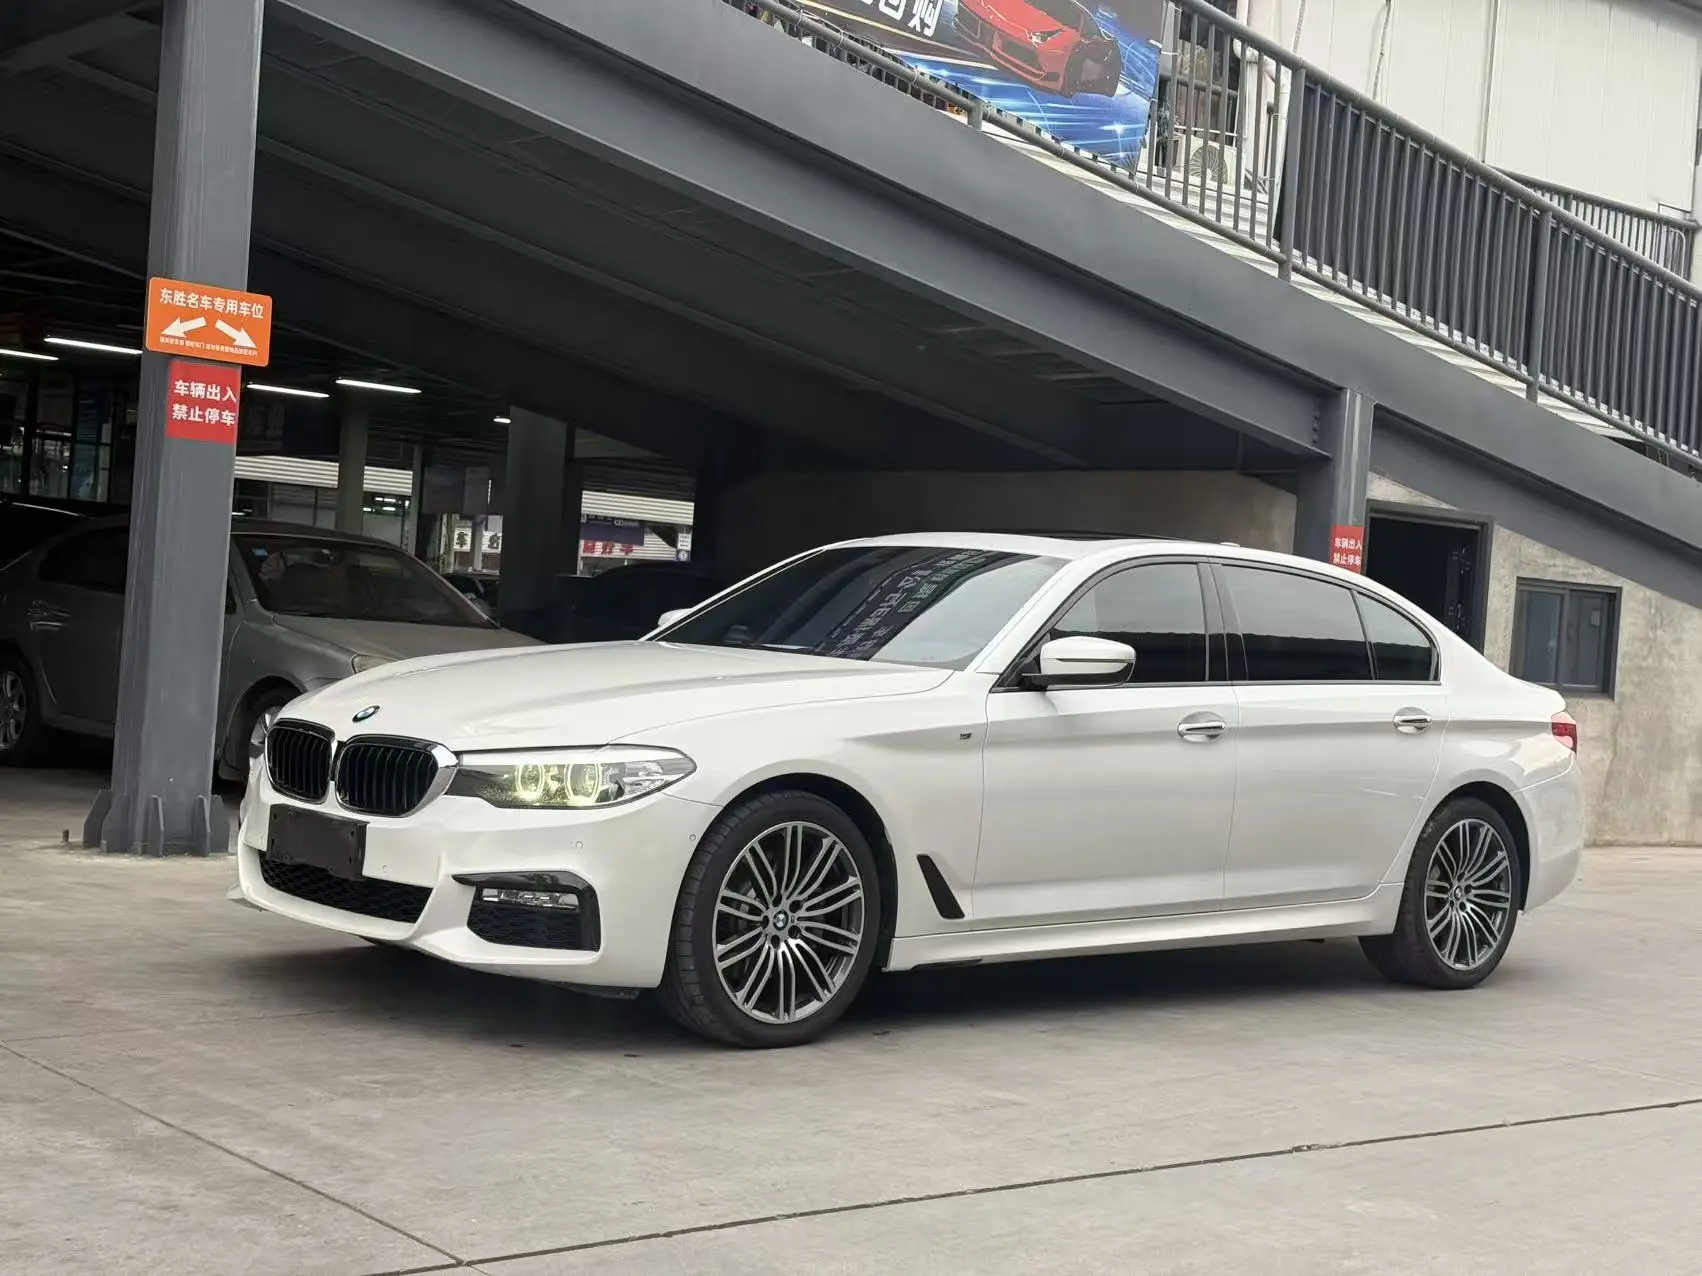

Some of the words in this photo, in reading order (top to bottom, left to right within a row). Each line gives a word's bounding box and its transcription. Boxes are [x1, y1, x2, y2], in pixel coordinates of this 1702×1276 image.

[160, 288, 264, 319] 东胜名车专用车位
[173, 380, 237, 403] 车辆出入
[172, 403, 236, 427] 禁止停车
[1334, 536, 1363, 550] 车辆出入
[1333, 552, 1362, 567] 禁止停车
